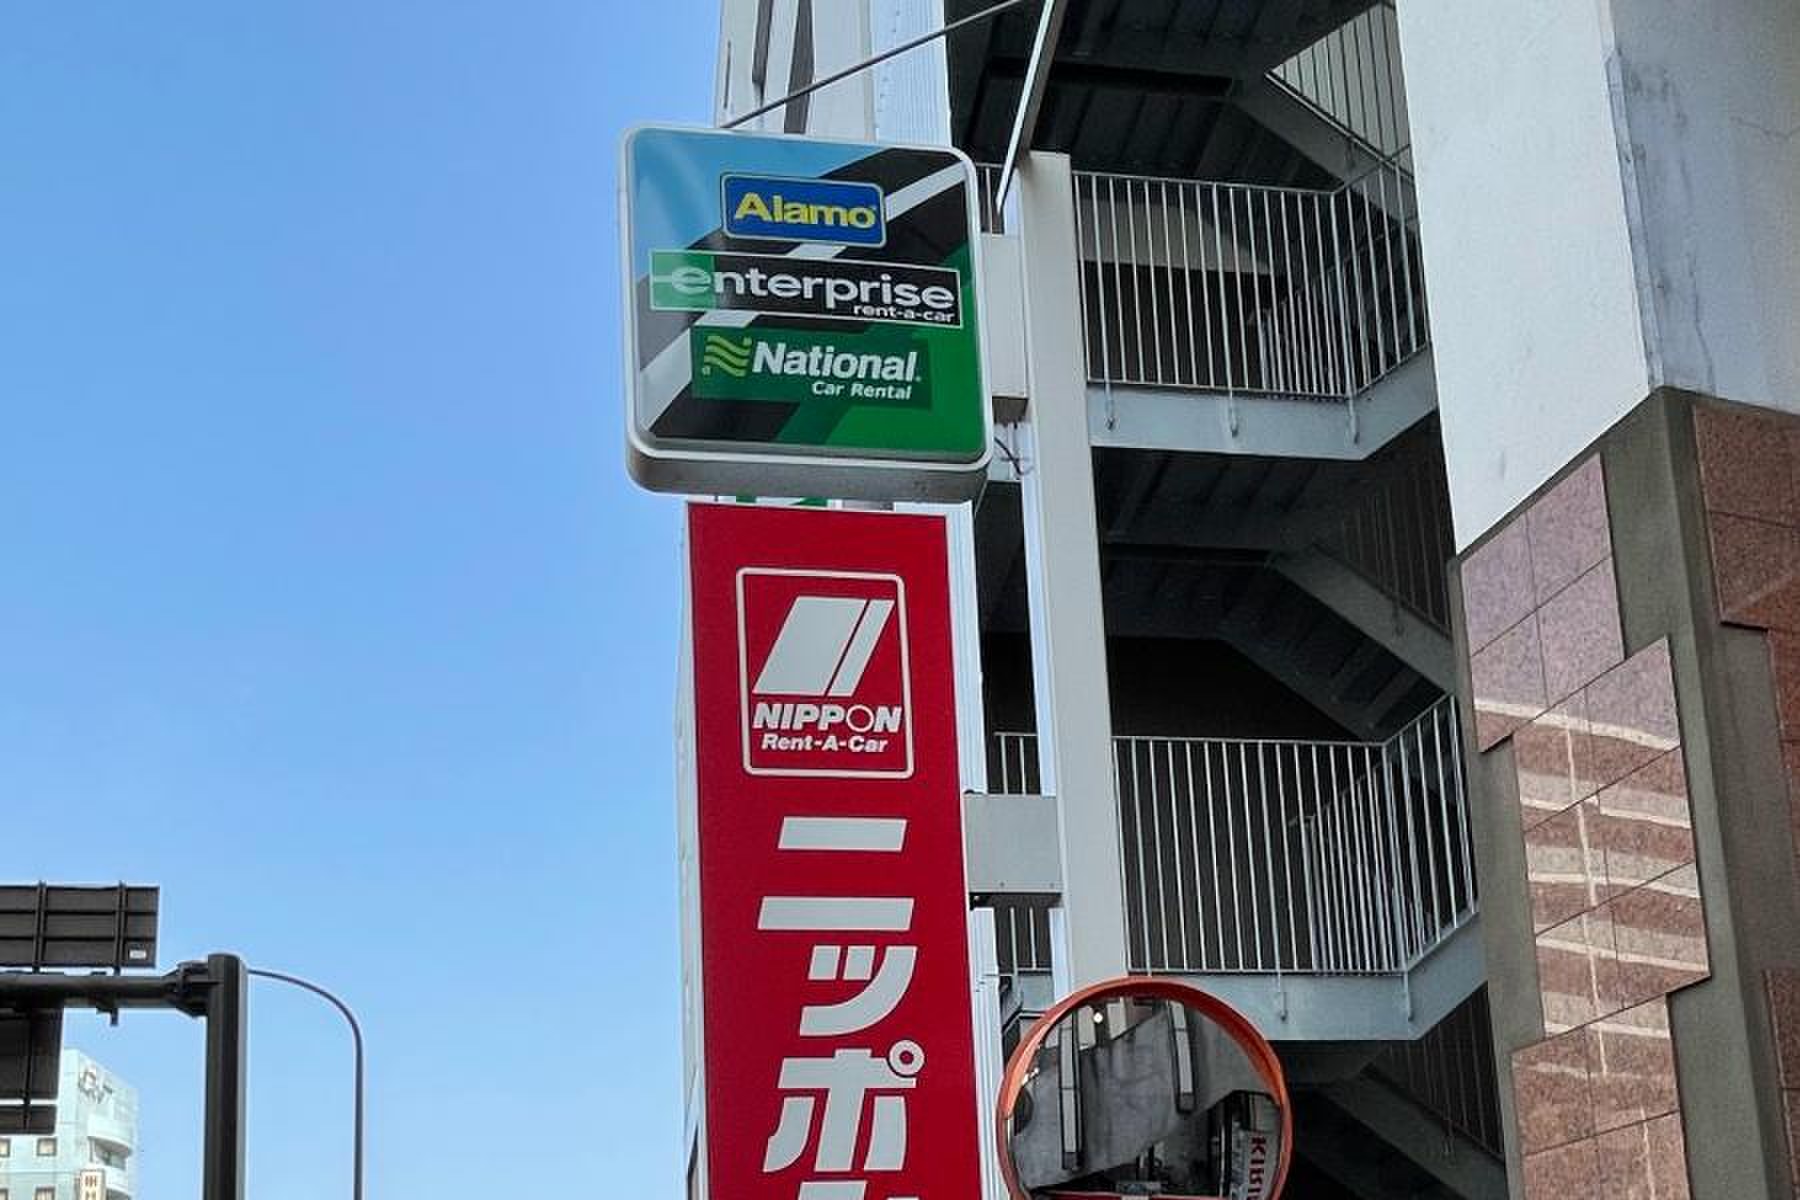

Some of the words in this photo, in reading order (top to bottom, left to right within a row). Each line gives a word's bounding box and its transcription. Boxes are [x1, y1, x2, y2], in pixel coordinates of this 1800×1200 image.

[735, 192, 876, 229] Alamo
[671, 266, 955, 309] enterprise
[854, 304, 955, 322] rent-a-car
[752, 341, 918, 382] National
[811, 381, 845, 396] Car
[850, 383, 912, 400] Rental
[752, 702, 902, 733] NIPPON
[761, 733, 889, 753] Rent-A-Car
